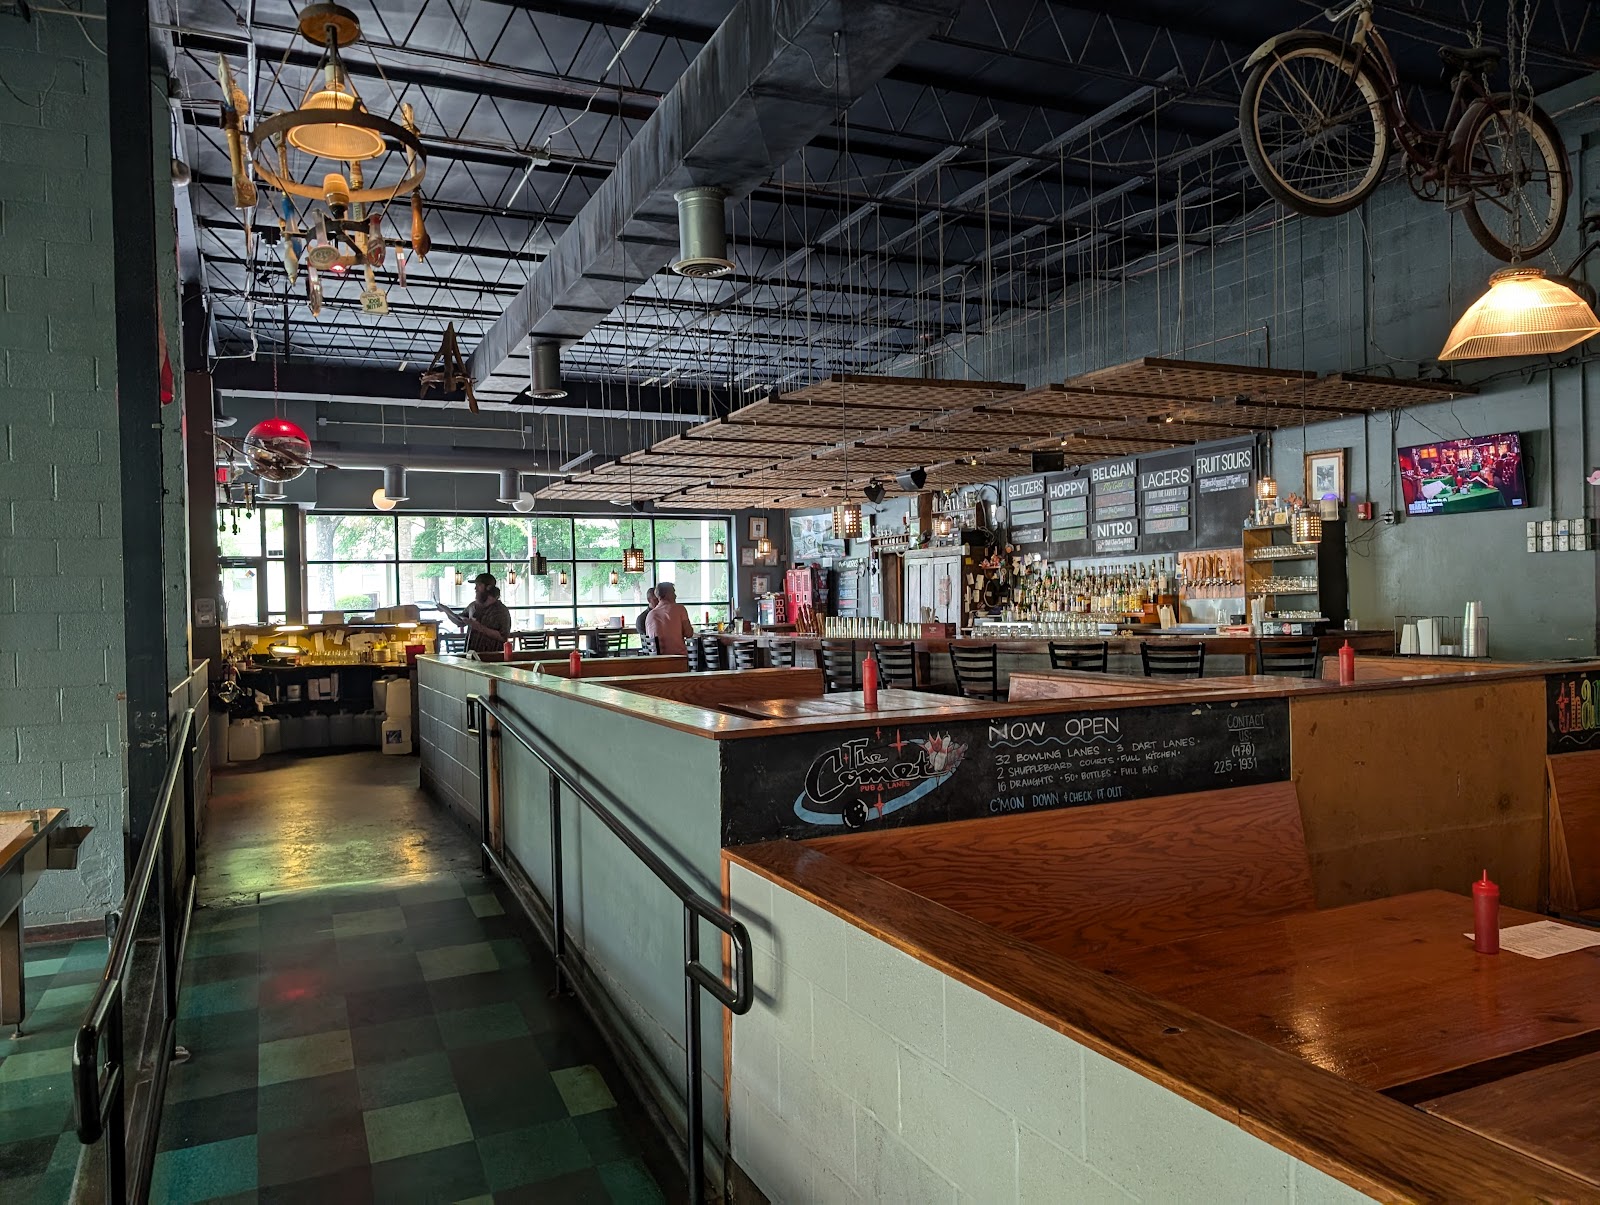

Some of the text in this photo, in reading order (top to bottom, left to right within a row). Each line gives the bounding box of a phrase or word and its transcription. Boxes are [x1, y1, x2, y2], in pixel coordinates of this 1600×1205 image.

[1092, 461, 1134, 481] BELGIAN
[1196, 450, 1251, 475] FRUIT SOURS
[1008, 479, 1044, 497] SELTZERS
[1142, 468, 1190, 489] LAGERS
[1050, 481, 1085, 498] HOPPY
[1097, 521, 1133, 537] NITRO
[776, 599, 785, 624] BRE
[988, 717, 1119, 741] NOW OPEN
[1226, 713, 1265, 729] CONTACT
[1238, 730, 1252, 742] US:
[842, 738, 888, 769] The
[995, 737, 1196, 766] 32 BOWLING LANES 3 DART LANES
[1231, 743, 1255, 757] (470)
[997, 750, 1177, 779] 2 SHUFFLEBOARD COURTS FULL KITCHEN
[1213, 757, 1257, 774] 225-1931
[805, 748, 950, 803] Comet
[860, 780, 911, 792] PUB & LANES
[997, 765, 1159, 792] 16 DRAUGHTS 50+ BOTTLES FULL BAR
[989, 795, 1025, 812] C'MON
[1032, 792, 1060, 807] DOWN
[1069, 790, 1093, 803] CHECK
[1096, 787, 1105, 799] IT
[1106, 786, 1123, 798] OUT
